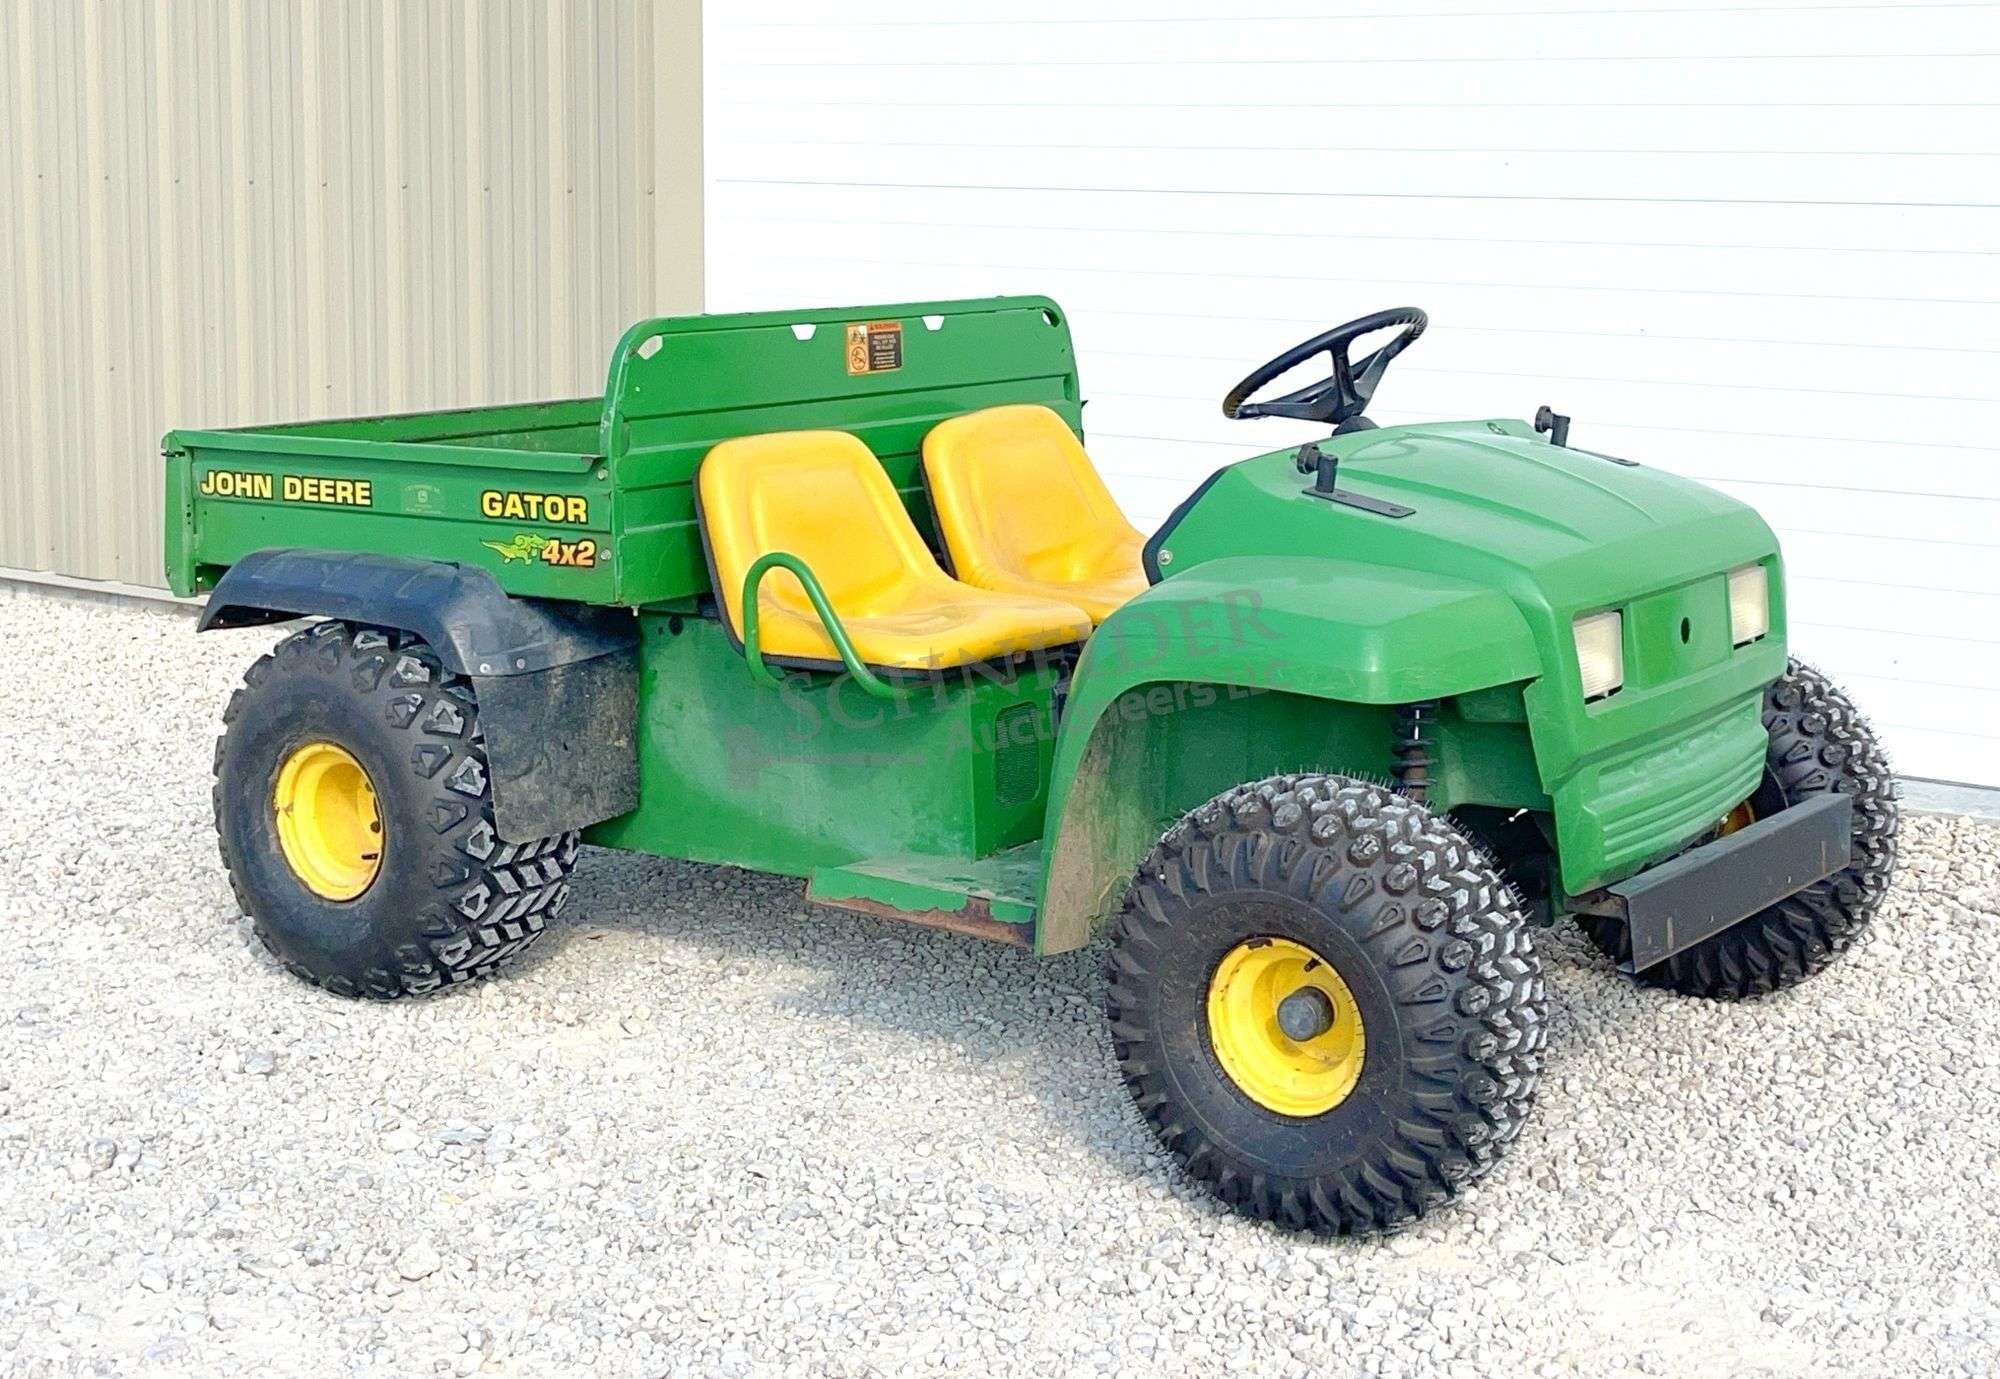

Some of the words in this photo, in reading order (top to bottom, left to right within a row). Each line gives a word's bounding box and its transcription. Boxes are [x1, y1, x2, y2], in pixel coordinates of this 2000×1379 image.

[201, 470, 273, 499] JOHN
[283, 475, 372, 507] DEERE
[481, 489, 588, 524] GATOR
[540, 537, 597, 568] 4x2
